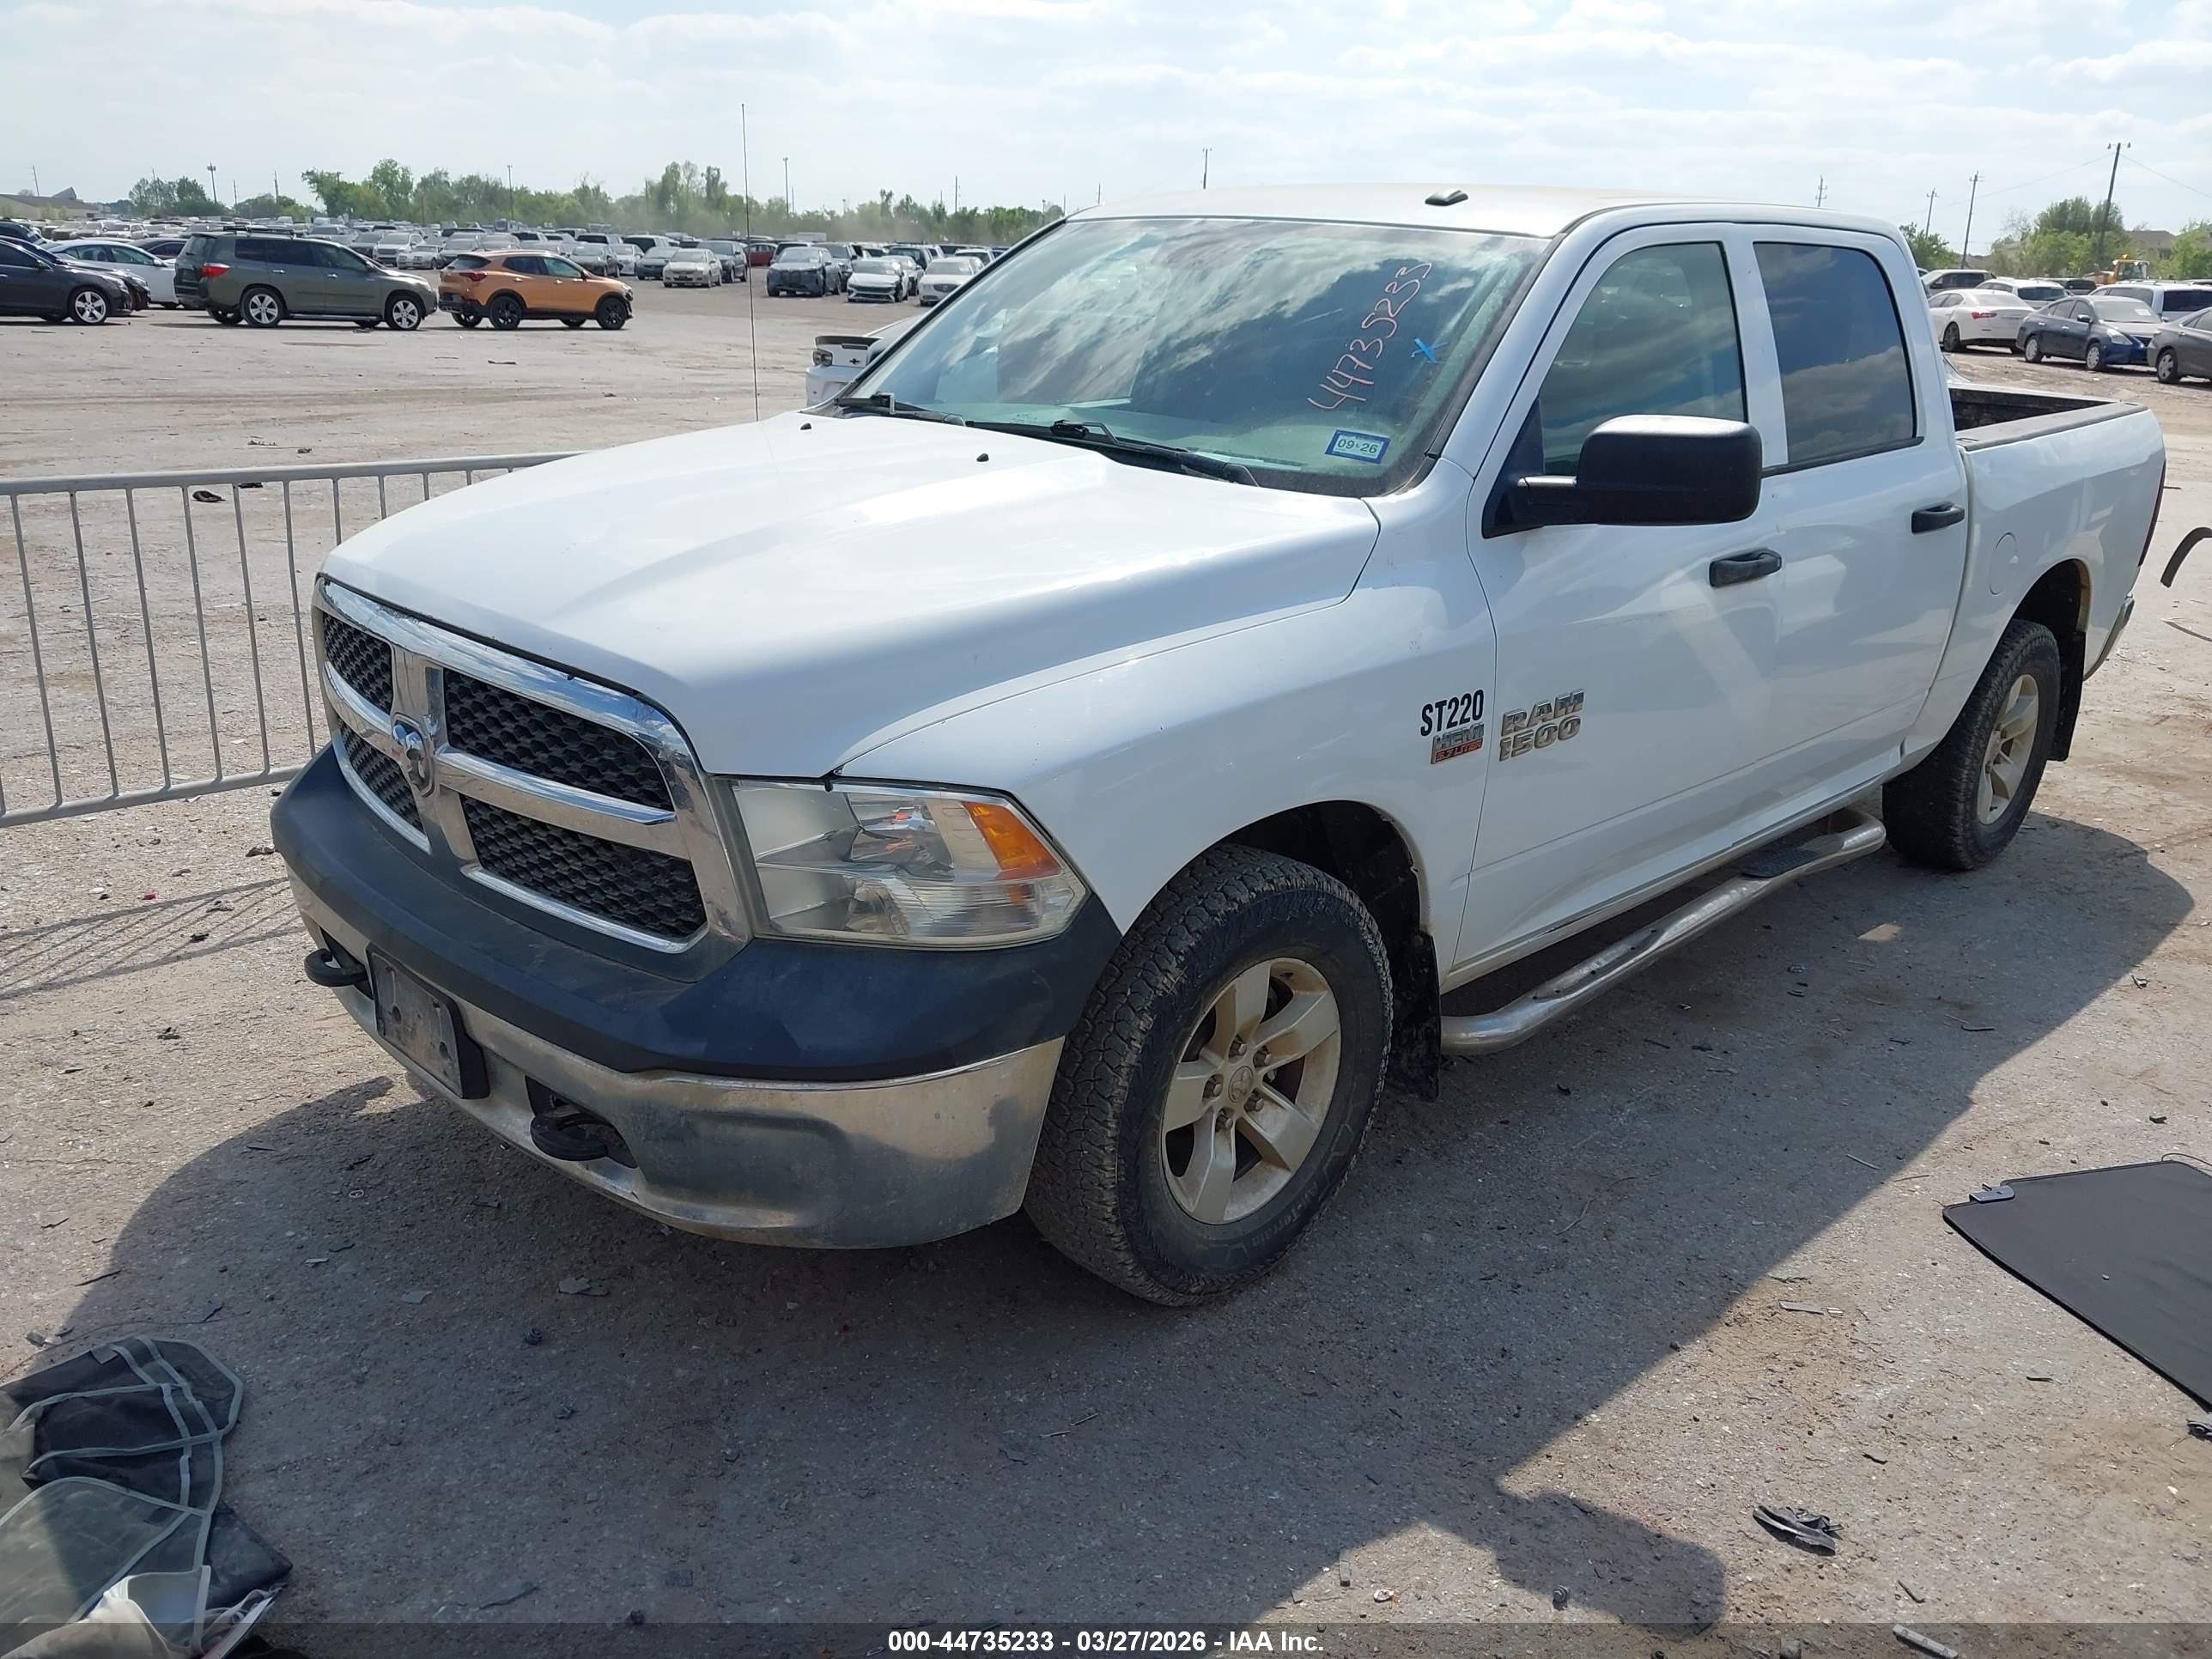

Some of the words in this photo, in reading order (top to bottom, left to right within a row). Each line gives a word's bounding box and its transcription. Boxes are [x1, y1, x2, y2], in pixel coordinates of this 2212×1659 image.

[1307, 262, 1432, 410] 44735233
[1420, 689, 1485, 737] ST220
[1433, 723, 1485, 750] HEMI
[1501, 689, 1585, 737] RAM
[1499, 715, 1582, 762] 1500
